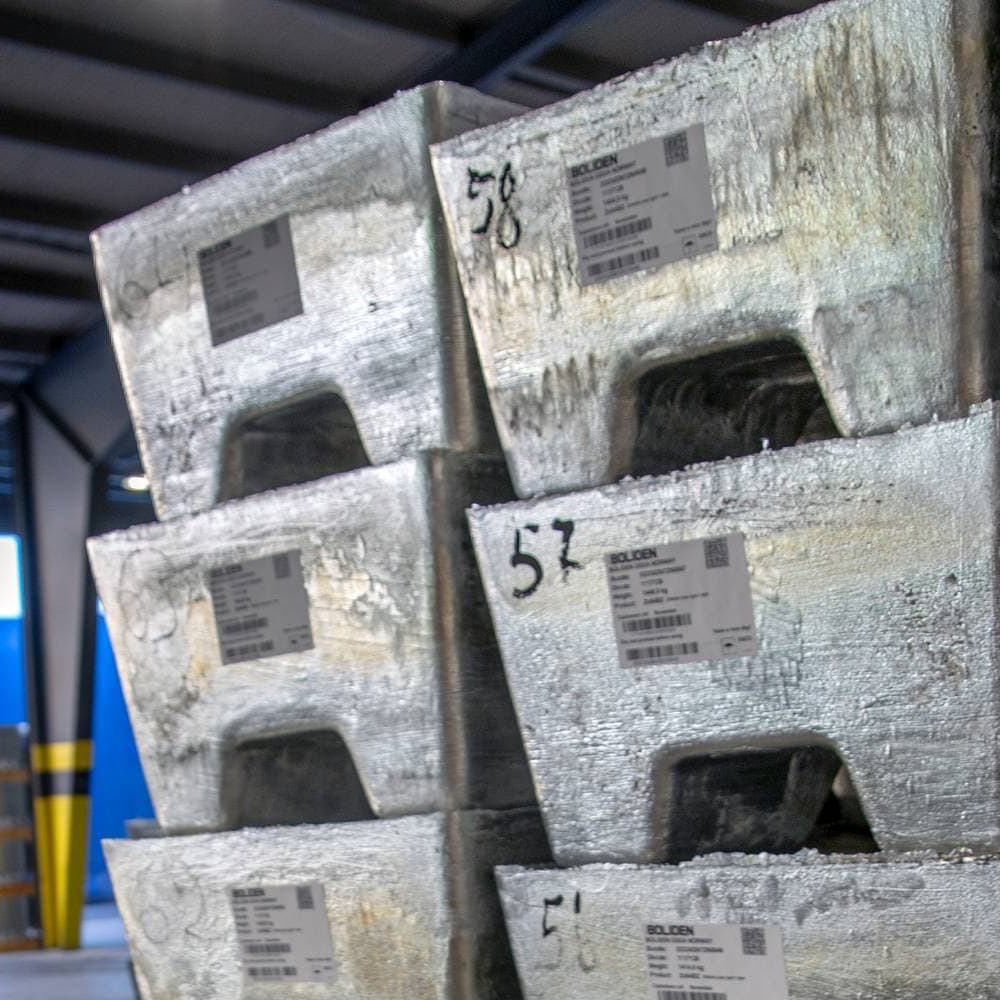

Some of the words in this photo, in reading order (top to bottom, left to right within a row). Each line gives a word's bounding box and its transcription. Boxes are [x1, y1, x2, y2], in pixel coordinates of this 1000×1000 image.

[571, 153, 618, 178] BOLIDEN
[467, 162, 520, 249] 58
[510, 518, 583, 599] 57
[610, 547, 658, 564] BOLIDEN
[646, 924, 694, 936] BOLIDEN
